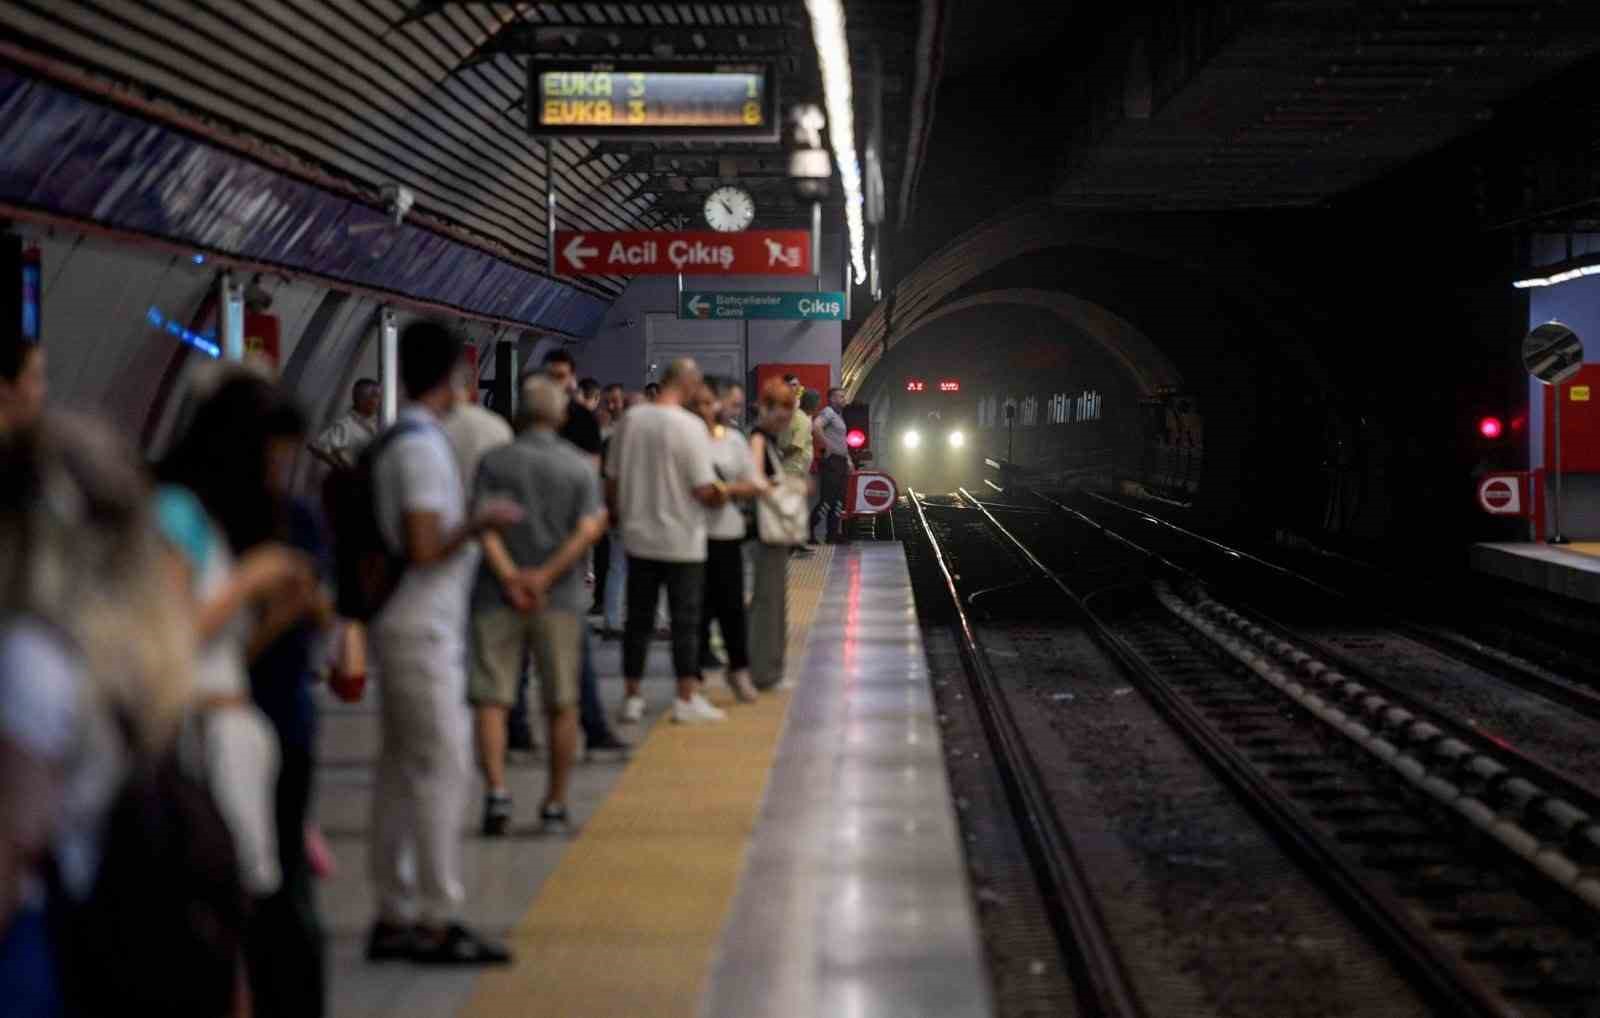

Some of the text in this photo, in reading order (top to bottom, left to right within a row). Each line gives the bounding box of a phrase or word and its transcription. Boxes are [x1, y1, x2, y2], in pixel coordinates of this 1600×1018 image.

[625, 73, 645, 97] 3
[626, 100, 646, 125] 3
[607, 240, 734, 270] Acil Çıkış
[797, 297, 841, 316] Çıkış
